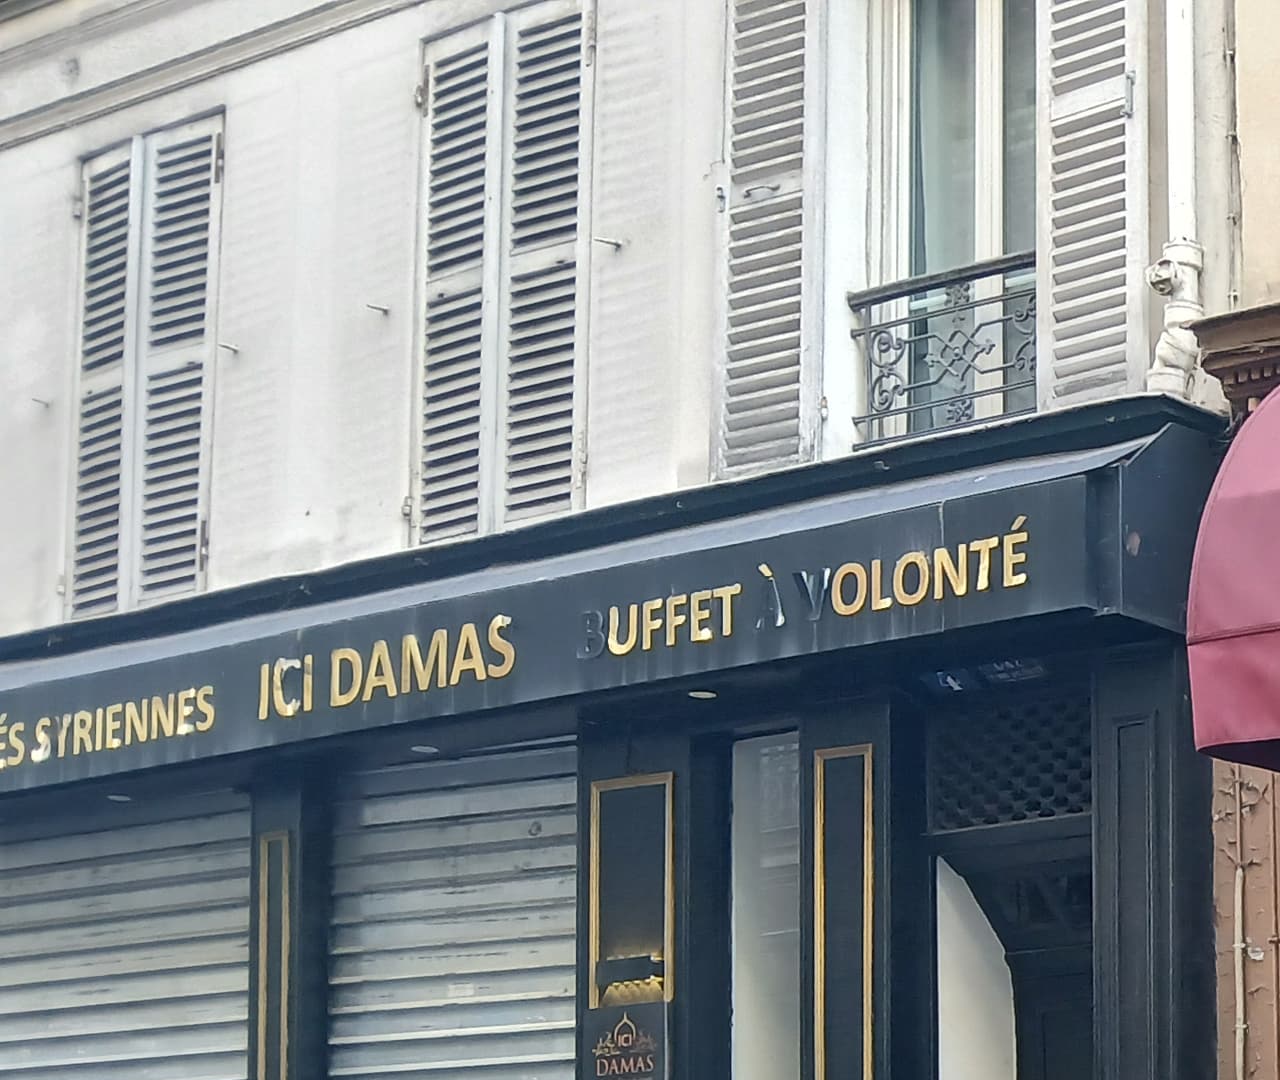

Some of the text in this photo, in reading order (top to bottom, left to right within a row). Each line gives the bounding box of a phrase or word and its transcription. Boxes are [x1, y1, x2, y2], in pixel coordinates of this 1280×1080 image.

[576, 582, 742, 659] BUFFET
[795, 515, 1028, 621] VOLONTÉ
[257, 614, 517, 720] ICI DAMAS
[31, 685, 215, 763] SYRIENNES
[596, 1054, 655, 1077] DAMAS
